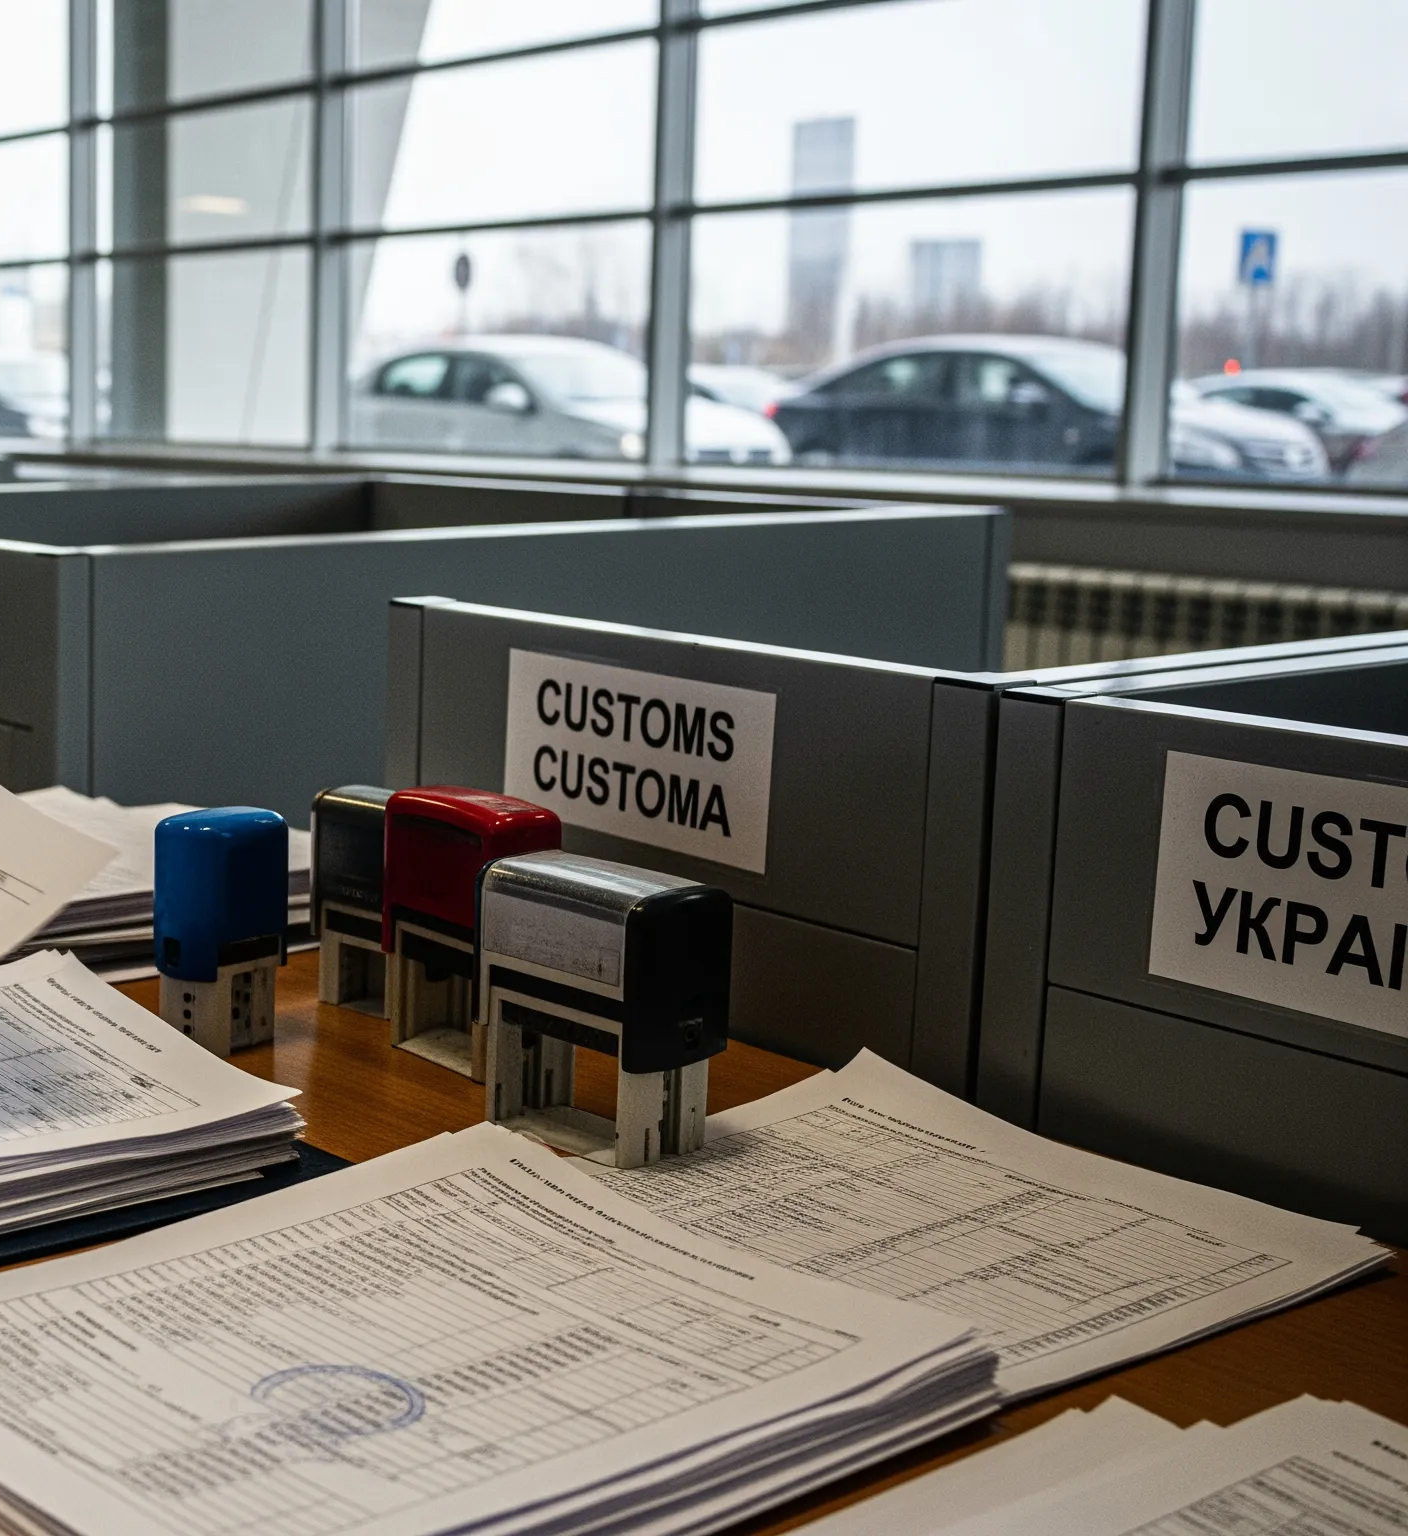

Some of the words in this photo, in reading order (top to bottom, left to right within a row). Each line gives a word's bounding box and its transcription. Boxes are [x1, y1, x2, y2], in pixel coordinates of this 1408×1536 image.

[537, 679, 735, 762] CUSTOMS
[533, 745, 731, 838] CUSTOMA
[1204, 792, 1408, 889] CUST
